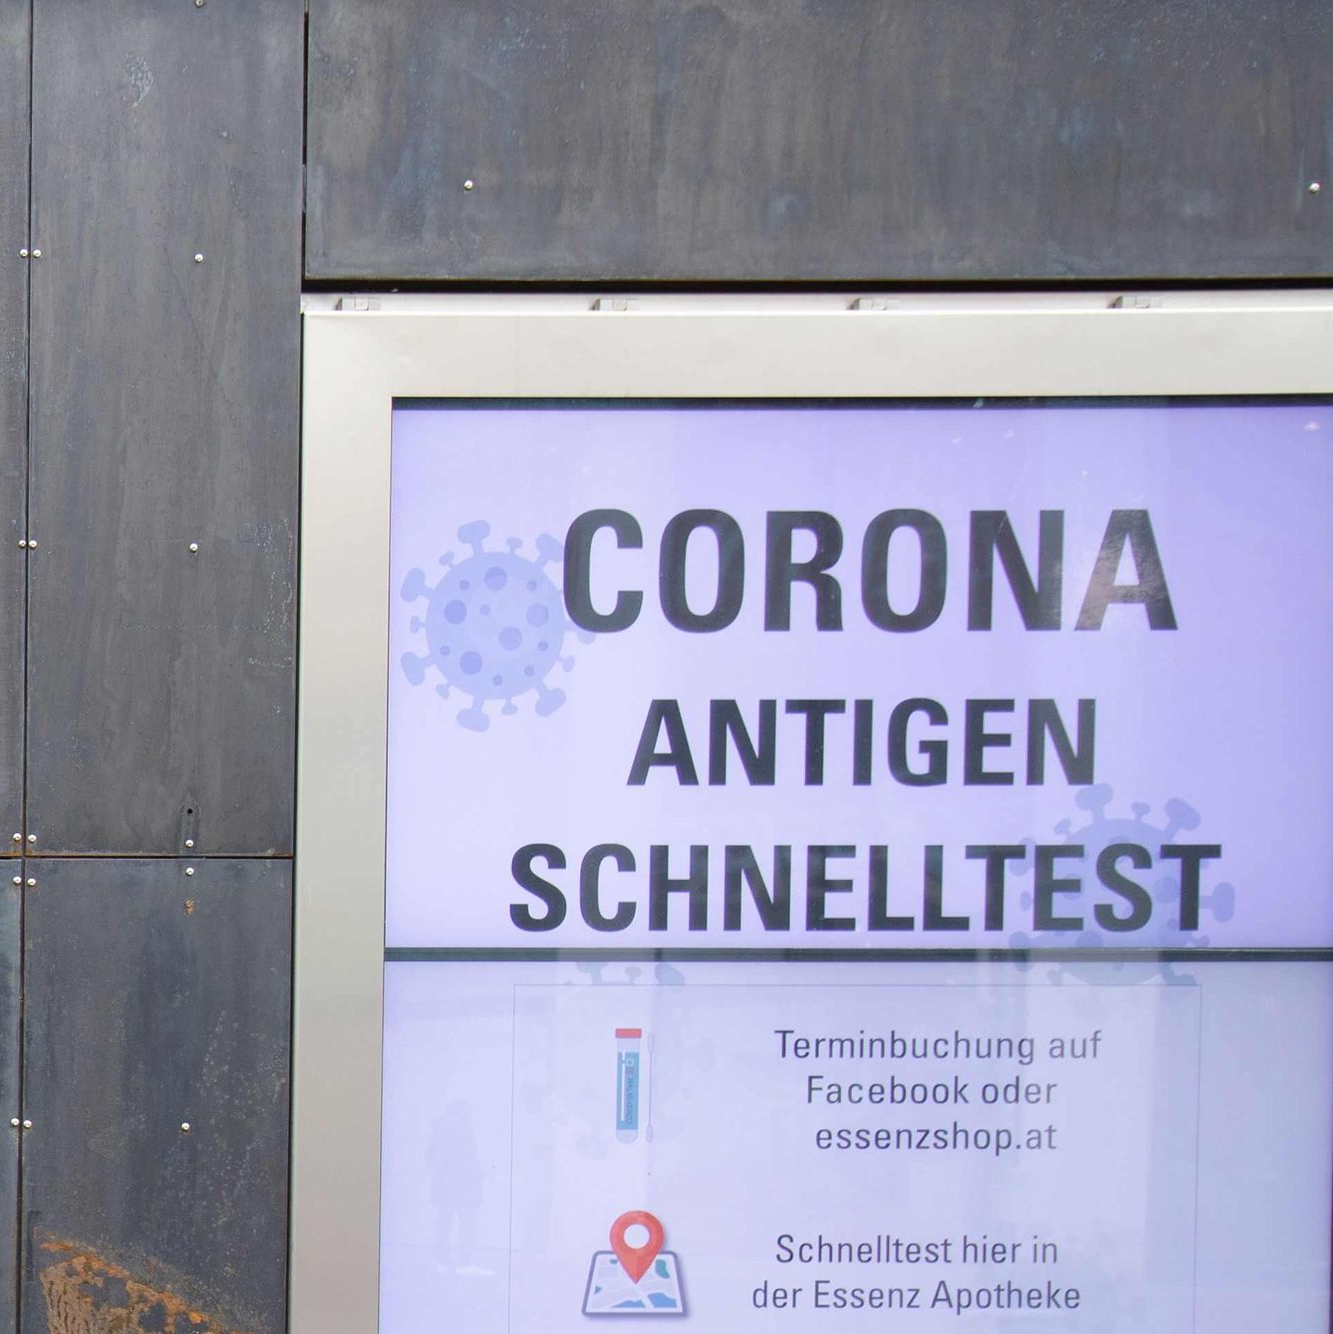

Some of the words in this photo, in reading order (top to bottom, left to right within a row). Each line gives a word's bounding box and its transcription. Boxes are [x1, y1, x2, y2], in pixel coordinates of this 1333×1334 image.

[562, 507, 1179, 635] CORONA
[626, 697, 1096, 788] ANTIGEN
[509, 842, 1223, 934] SCHNELLTEST
[774, 1029, 1036, 1065] Terminbuchung
[1048, 1029, 1102, 1060] auf
[806, 1075, 970, 1106] Facebook
[980, 1075, 1059, 1106] oder
[814, 1122, 1058, 1157] essenzshop.at
[775, 1234, 953, 1265] Schnelltest
[961, 1234, 1021, 1265] hier
[1031, 1234, 1059, 1264] in
[752, 1279, 803, 1310] der
[813, 1280, 921, 1310] Essenz
[930, 1280, 1081, 1316] Apotheke
